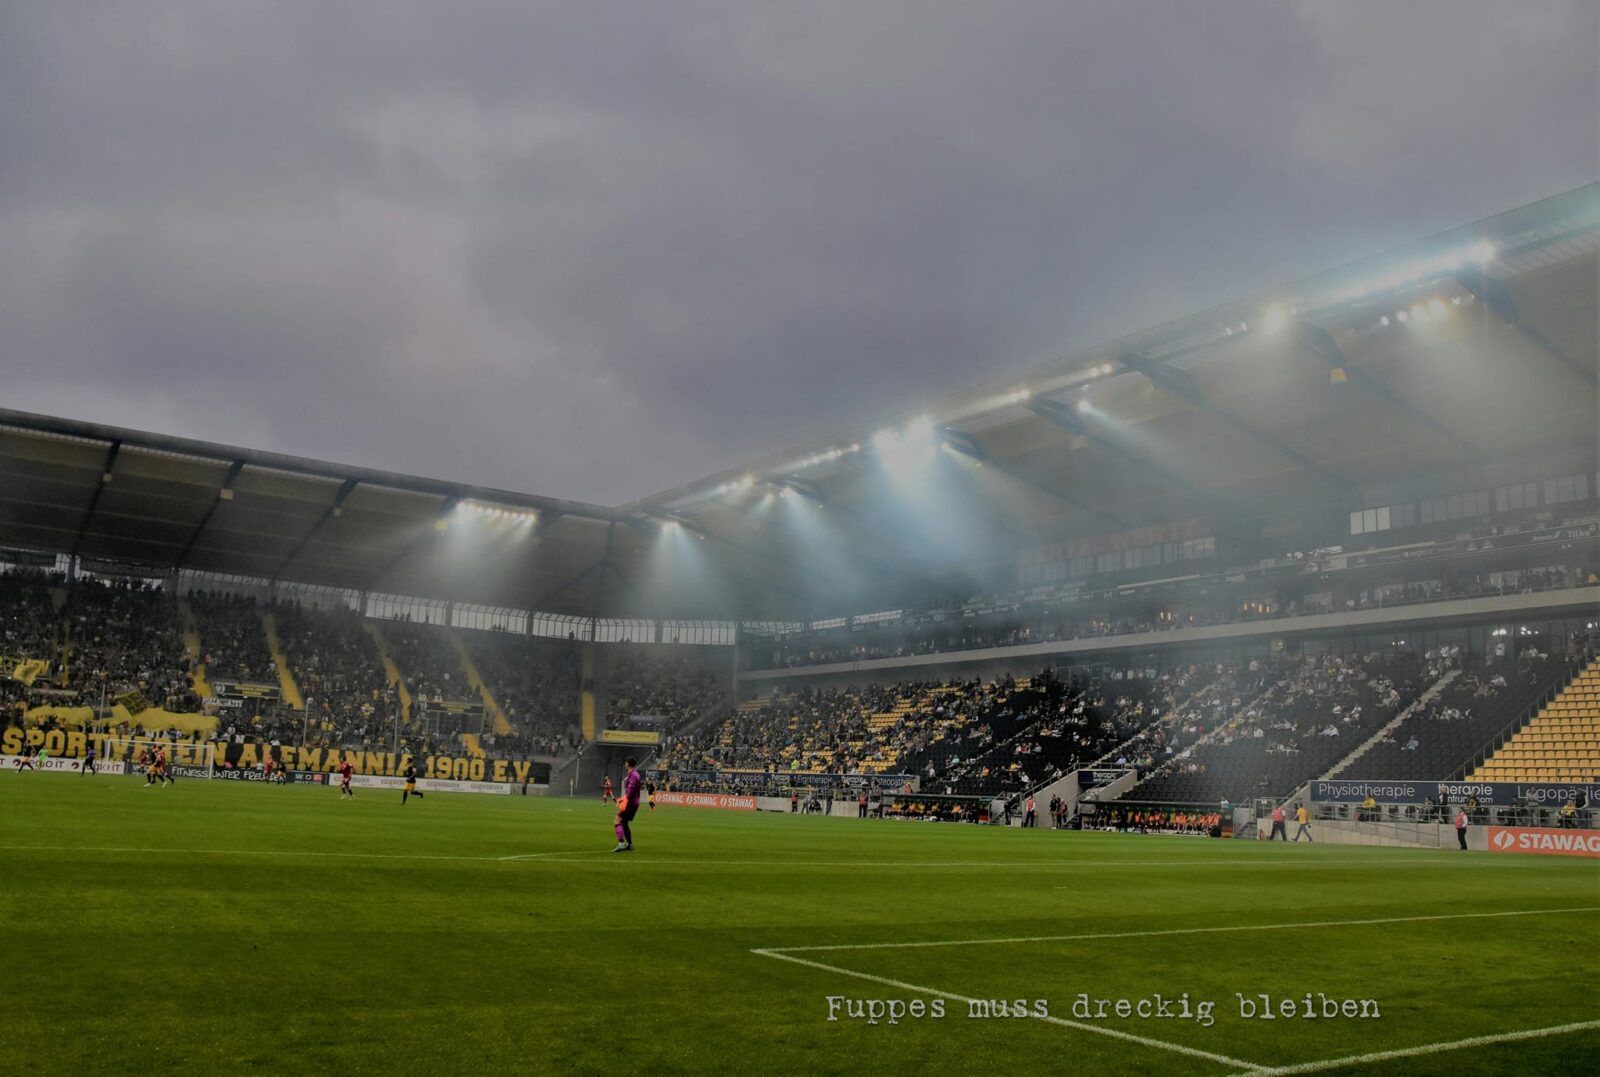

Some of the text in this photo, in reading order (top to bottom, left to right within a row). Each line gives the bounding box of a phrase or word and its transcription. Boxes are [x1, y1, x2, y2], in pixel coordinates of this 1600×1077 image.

[172, 766, 208, 778] FITNESS
[425, 755, 485, 781] 1900
[1319, 783, 1416, 799] Physiotherapie
[1438, 783, 1493, 796] therapie
[662, 793, 684, 803] STAWAG
[694, 795, 717, 806] STAWAG
[727, 797, 754, 808] STAWAG
[1519, 832, 1600, 852] STAWAG
